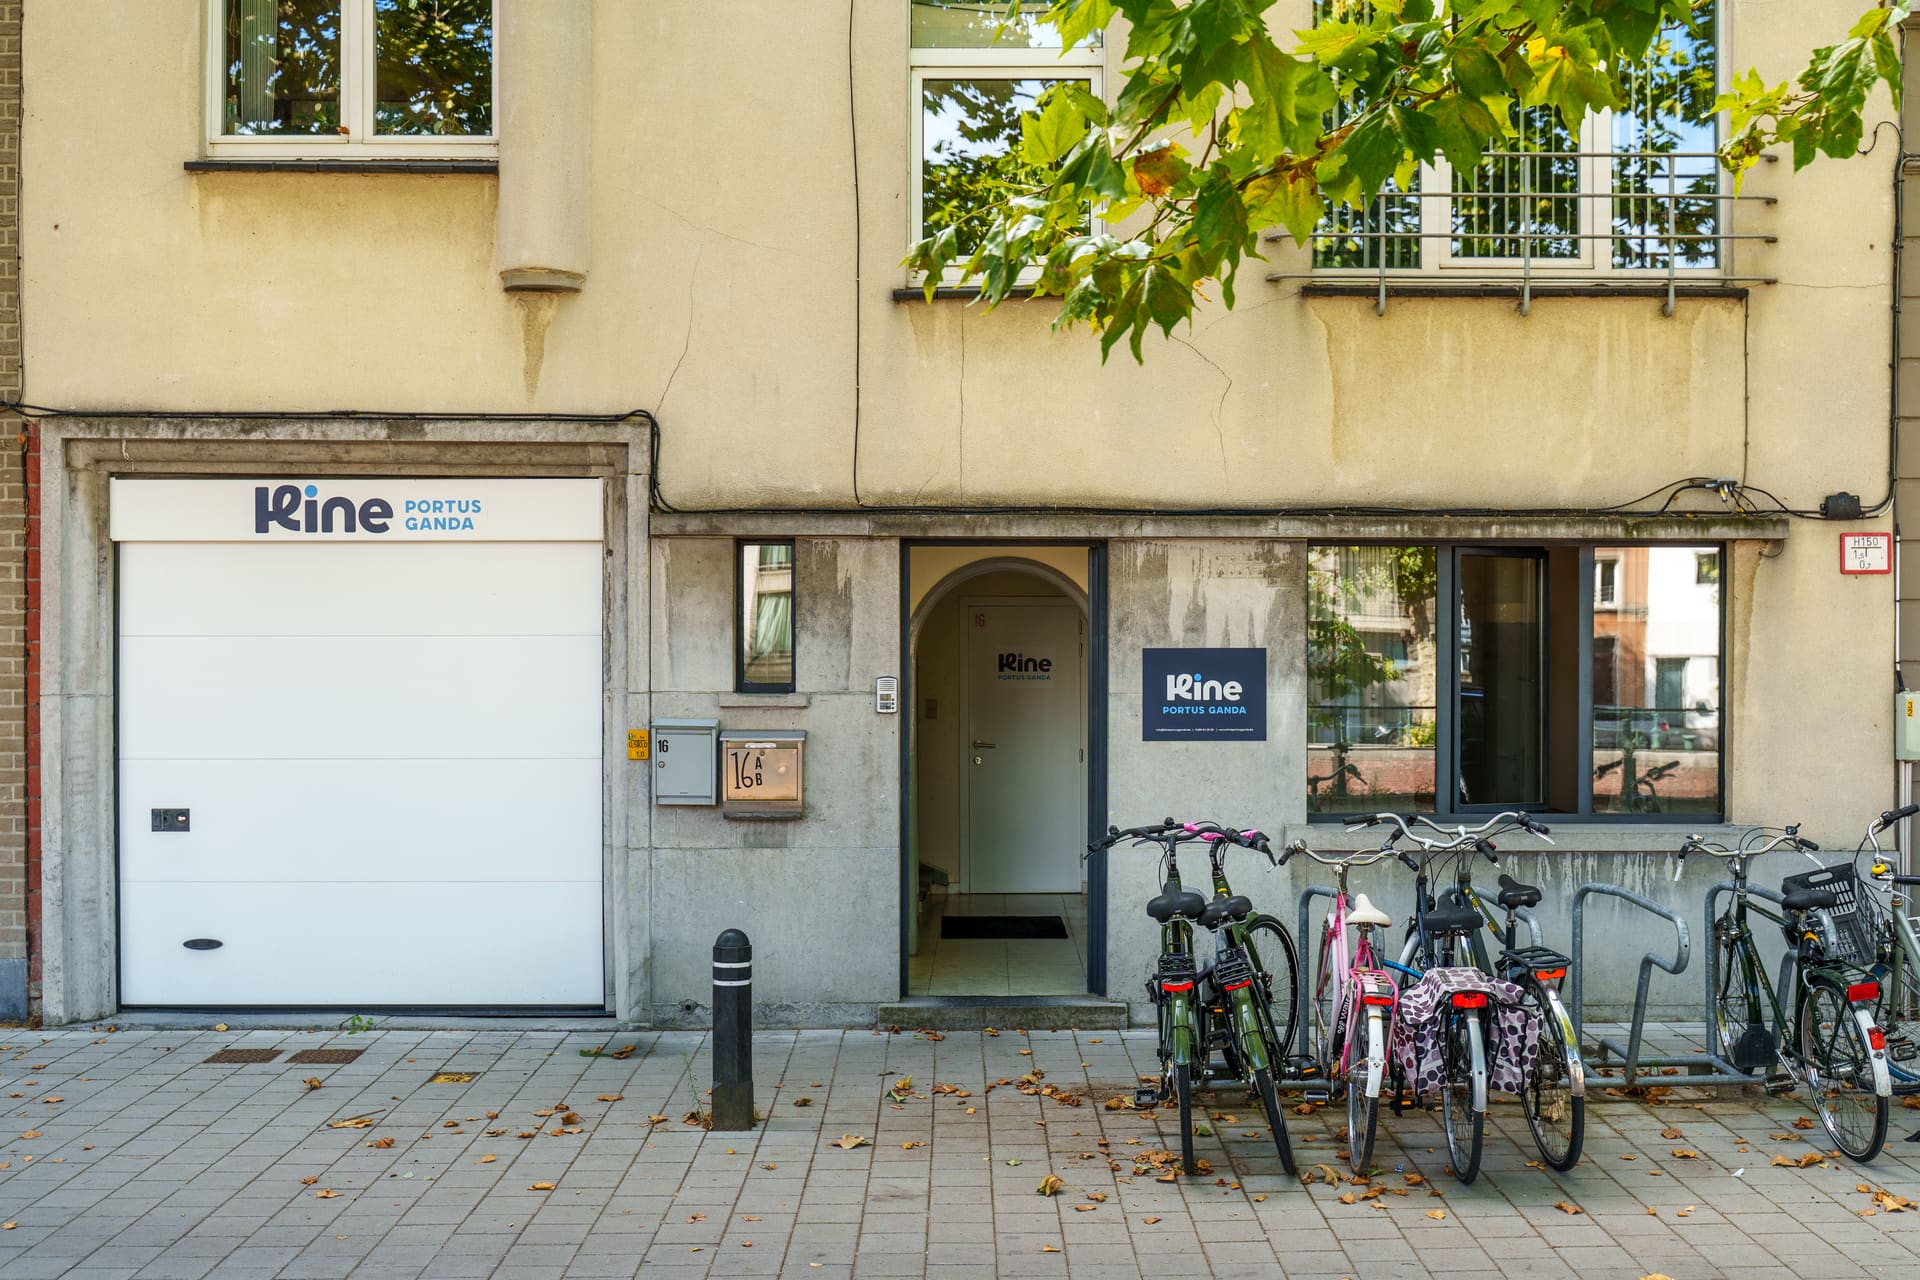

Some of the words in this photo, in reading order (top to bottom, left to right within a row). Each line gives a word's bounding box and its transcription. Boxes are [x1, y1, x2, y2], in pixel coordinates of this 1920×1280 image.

[255, 484, 394, 534] Kine
[405, 499, 481, 514] PORTUS
[405, 517, 474, 531] GANDA
[1853, 537, 1879, 547] H150
[998, 653, 1052, 673] Kine
[1166, 673, 1243, 701] Kine
[1162, 706, 1205, 715] PORTUS
[1208, 706, 1247, 715] GANDA
[657, 739, 669, 753] 16
[755, 756, 763, 770] A
[730, 751, 754, 790] 16
[755, 772, 763, 786] B
